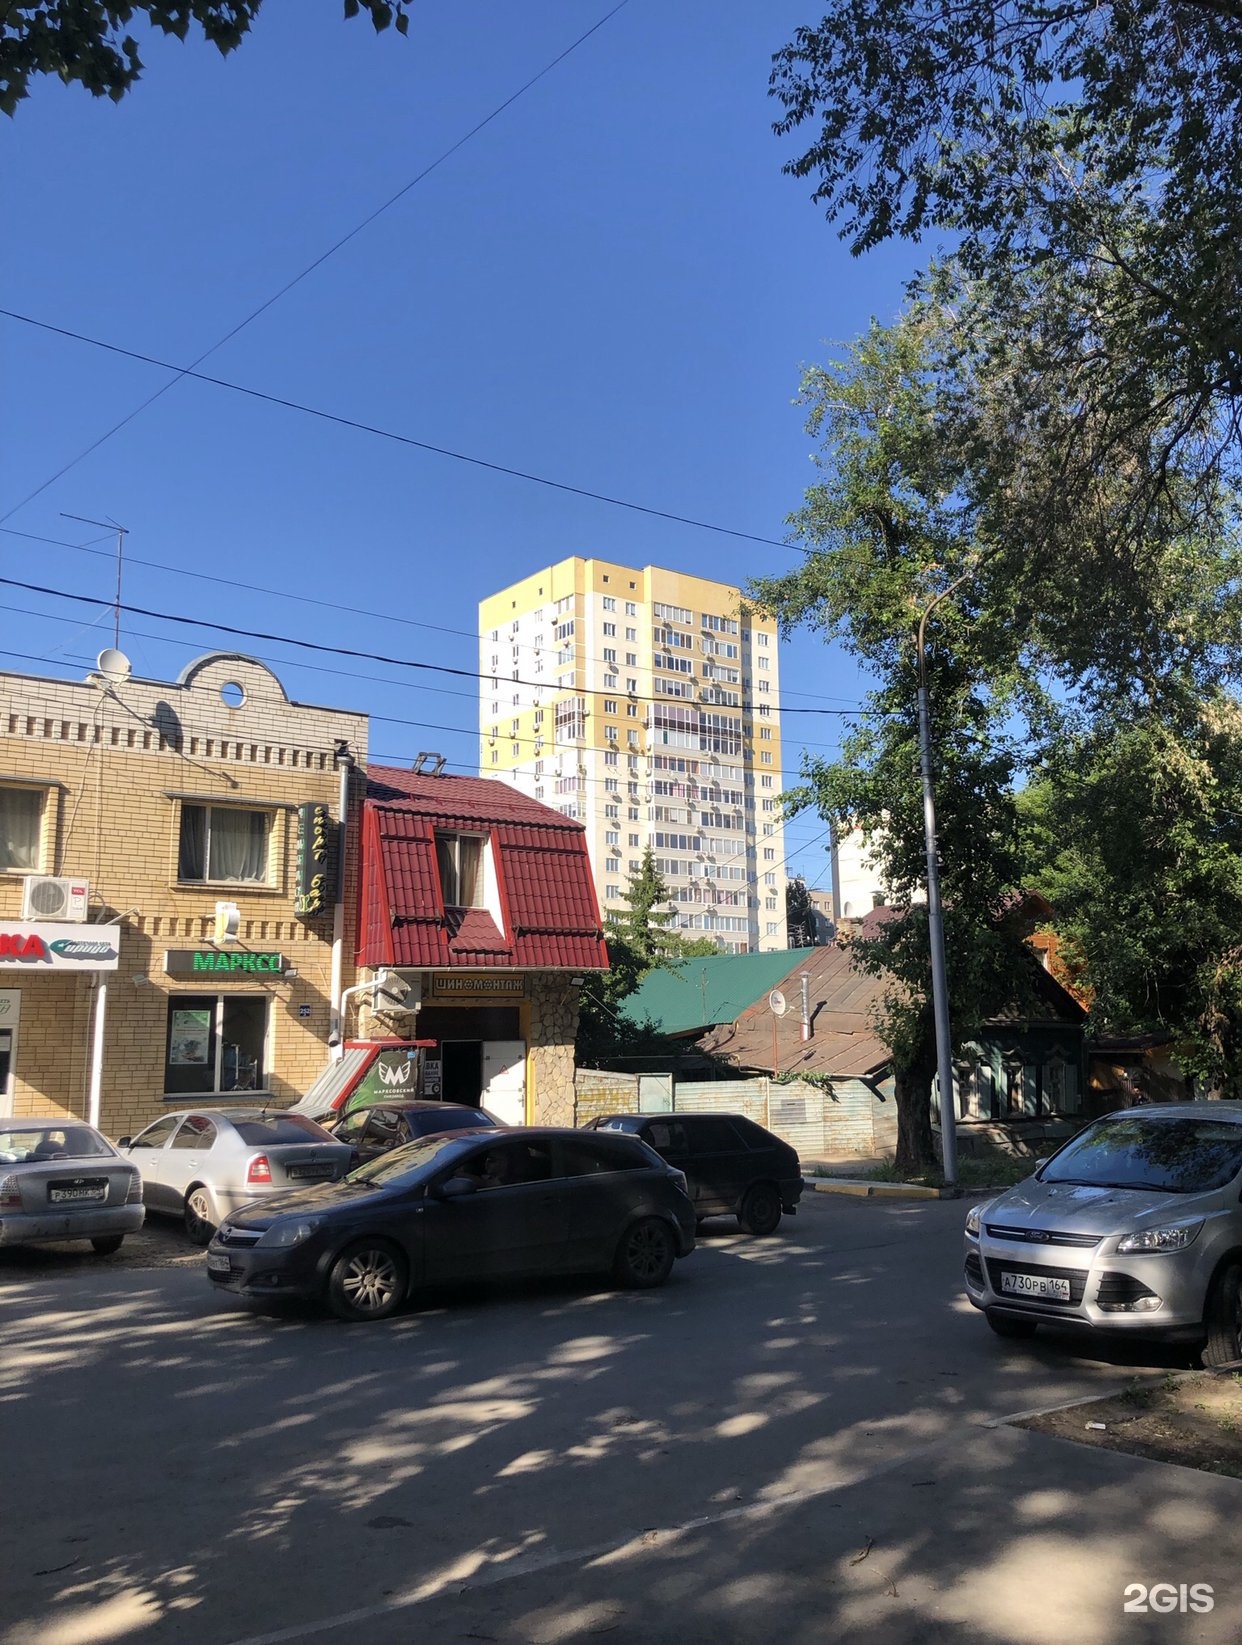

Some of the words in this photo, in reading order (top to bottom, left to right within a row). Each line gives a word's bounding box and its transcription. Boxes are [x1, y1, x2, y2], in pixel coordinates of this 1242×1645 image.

[312, 806, 325, 860] спорт
[307, 874, 324, 912] бар
[435, 979, 524, 990] ШИНОМОНТАЖ
[1049, 1279, 1067, 1291] 164
